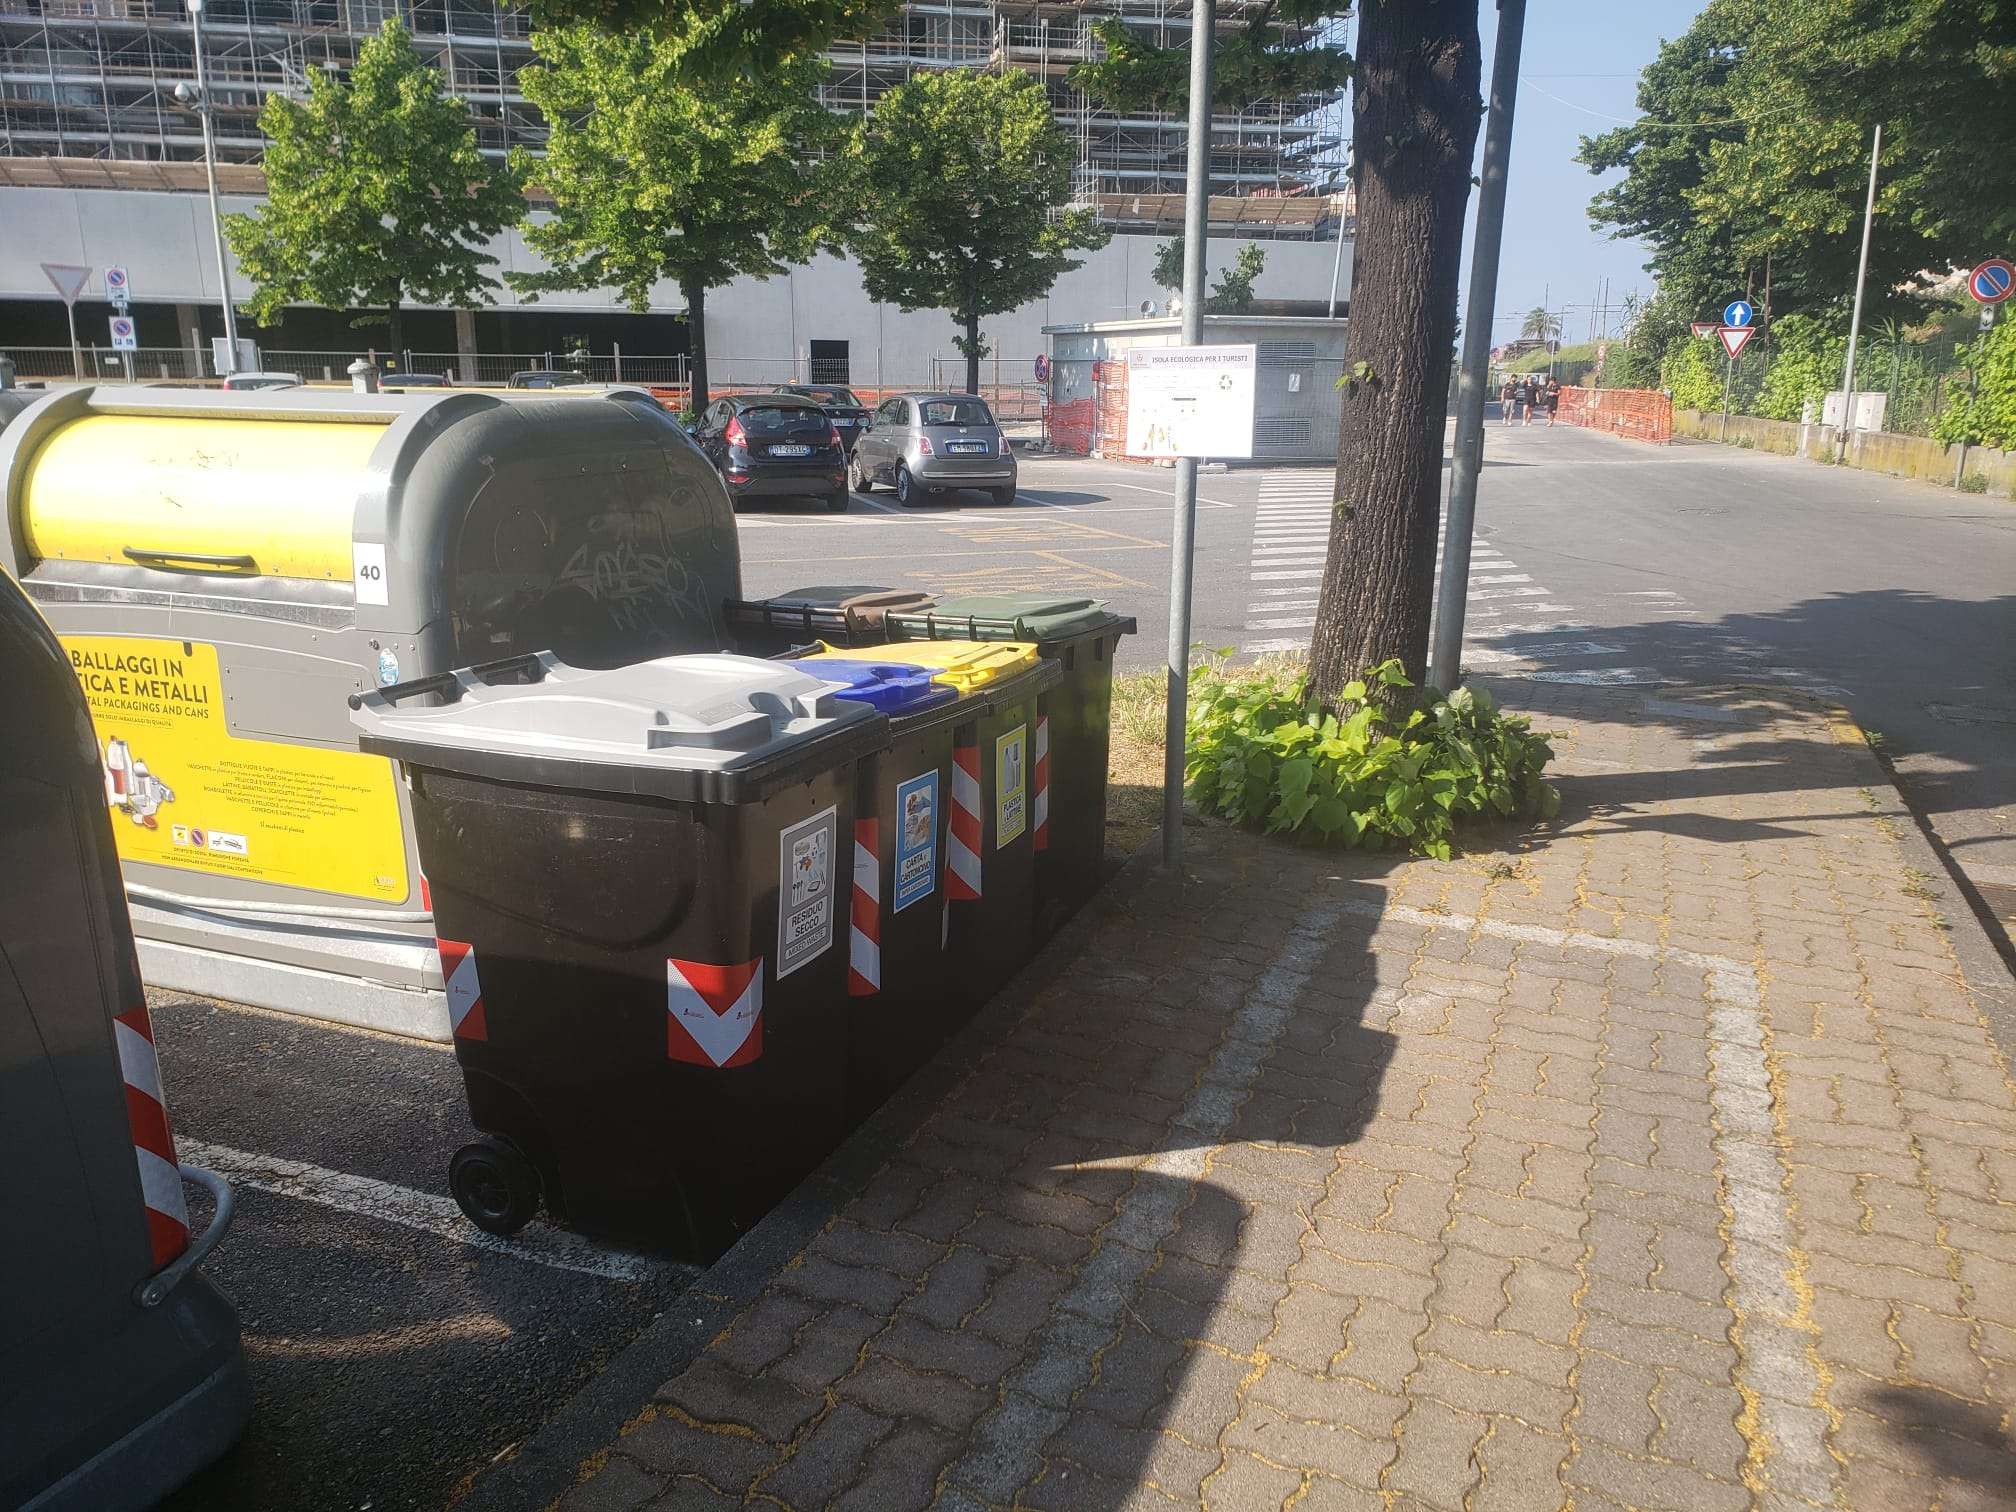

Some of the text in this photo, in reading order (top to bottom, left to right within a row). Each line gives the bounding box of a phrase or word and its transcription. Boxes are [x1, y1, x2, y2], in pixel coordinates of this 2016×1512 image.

[1152, 356, 1169, 364] ISOLA
[1170, 355, 1204, 364] ECOLOGICA
[1205, 355, 1217, 363] PER
[1223, 354, 1248, 363] TURISTI
[360, 565, 381, 581] 40
[70, 649, 184, 678] BALLAGGI IN
[119, 677, 129, 695] E
[134, 678, 209, 704] METALLI
[87, 695, 209, 719] TAL PACKAGINGS AND CANS
[906, 853, 923, 869] CARTA
[791, 900, 823, 928] RESIDUO
[795, 915, 819, 937] SECCO
